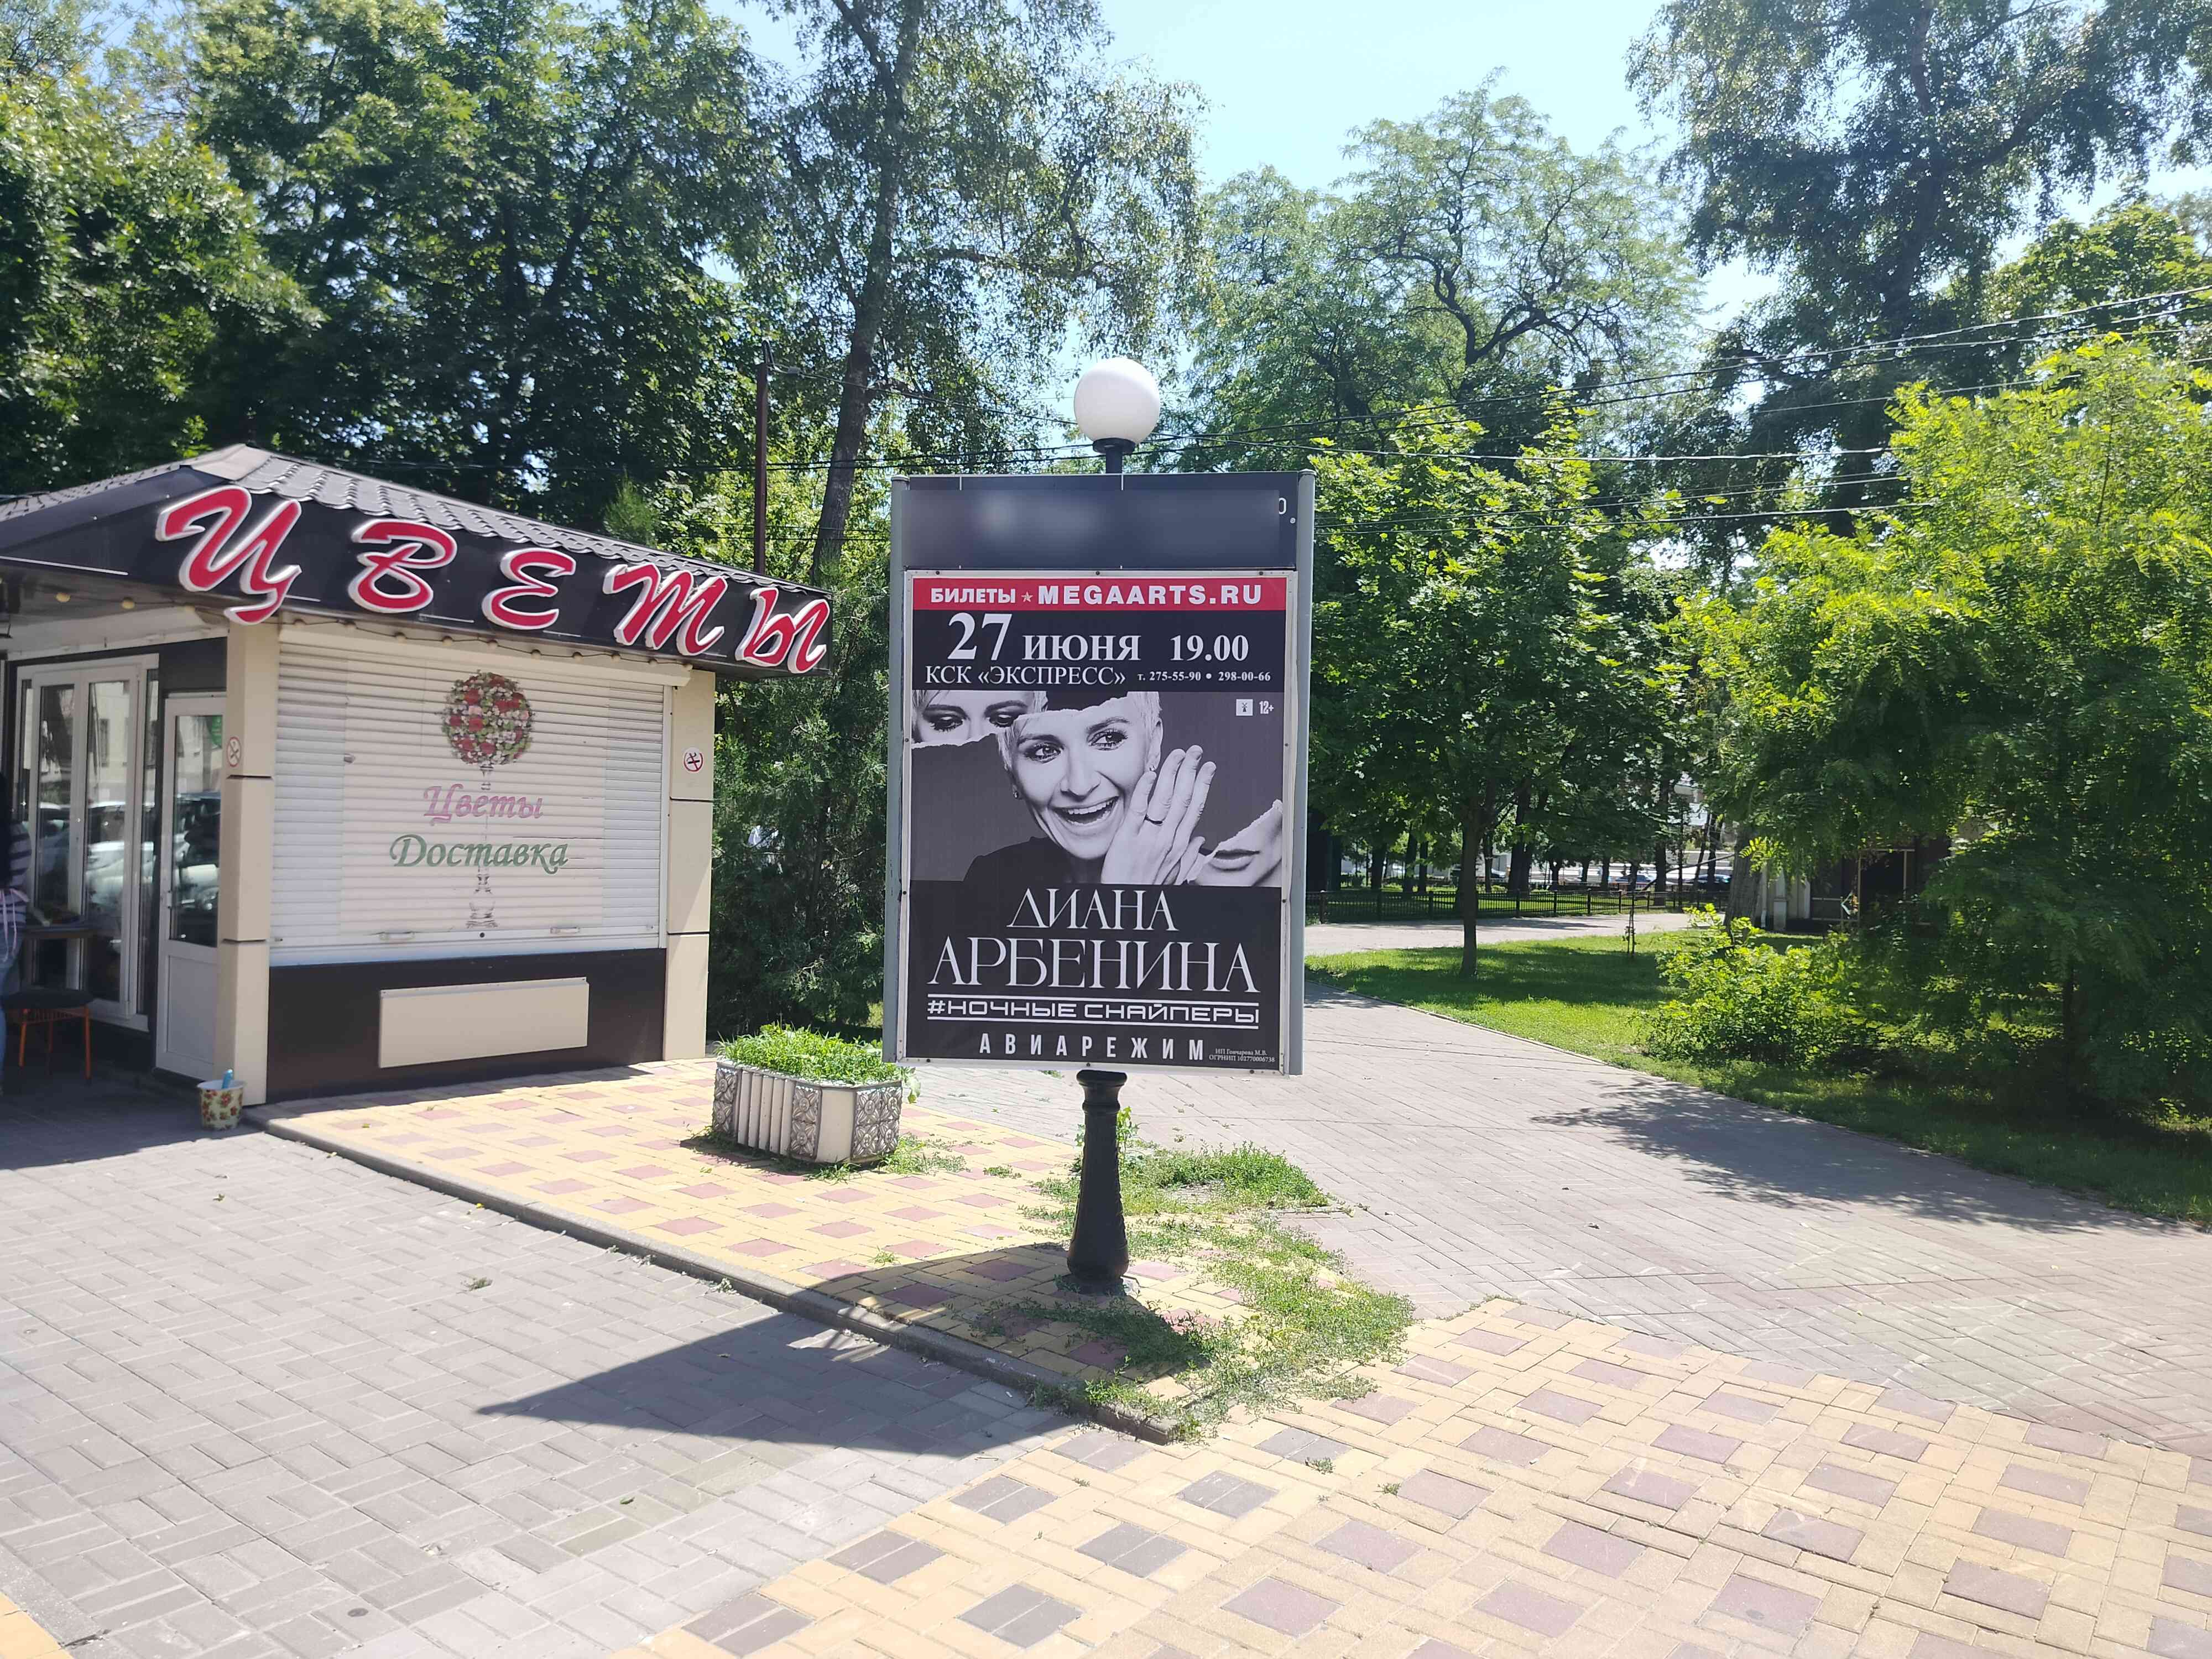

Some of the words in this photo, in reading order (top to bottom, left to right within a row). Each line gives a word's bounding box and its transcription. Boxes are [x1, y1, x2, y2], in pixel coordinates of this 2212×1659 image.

[931, 588, 1016, 603] БИЛЕТЫ
[1038, 585, 1261, 605] MEGAARTS.RU
[947, 612, 1013, 661] 27
[1022, 634, 1141, 661] ИЮНЯ
[1170, 635, 1249, 662] 19.00
[925, 665, 972, 684] КСК
[978, 666, 1126, 685] «ЭКСПРЕСС»
[1149, 671, 1201, 681] 275-55-90
[1218, 671, 1271, 681] 298-00-66
[1259, 700, 1274, 714] 12+
[422, 783, 544, 826] Цветы
[389, 834, 568, 875] Доставка
[1006, 888, 1179, 931] ДИАНА
[927, 936, 1261, 993] АРБЕНИНА
[927, 999, 1077, 1018] #НОЧНЫЕ
[1084, 1003, 1260, 1024] СНАЙПЕРЫ
[979, 1032, 1203, 1061] АВИАРЕЖИМ
